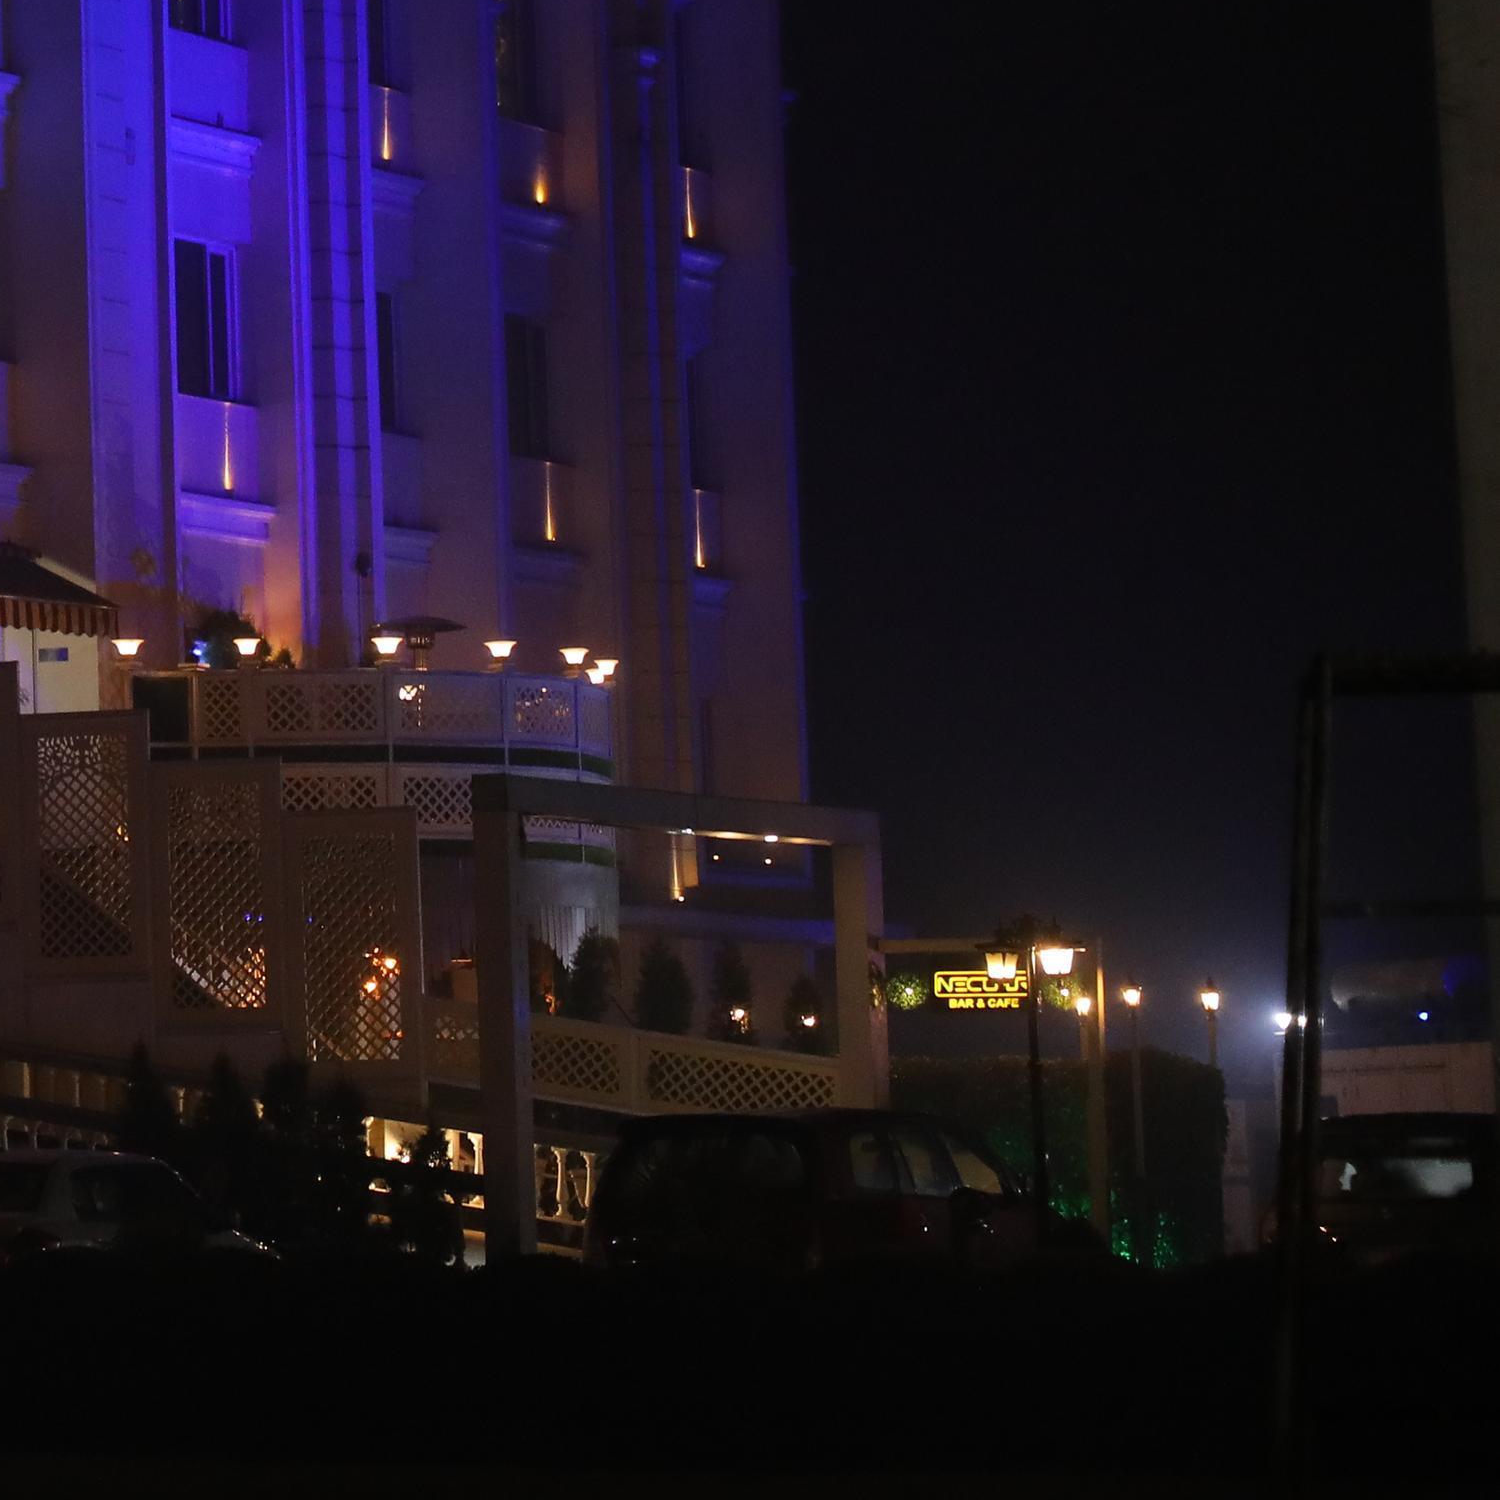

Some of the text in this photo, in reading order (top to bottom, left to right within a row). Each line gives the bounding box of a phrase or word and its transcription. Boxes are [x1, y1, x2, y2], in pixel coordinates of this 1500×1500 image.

[948, 998, 1019, 1009] BAR & CAFE
